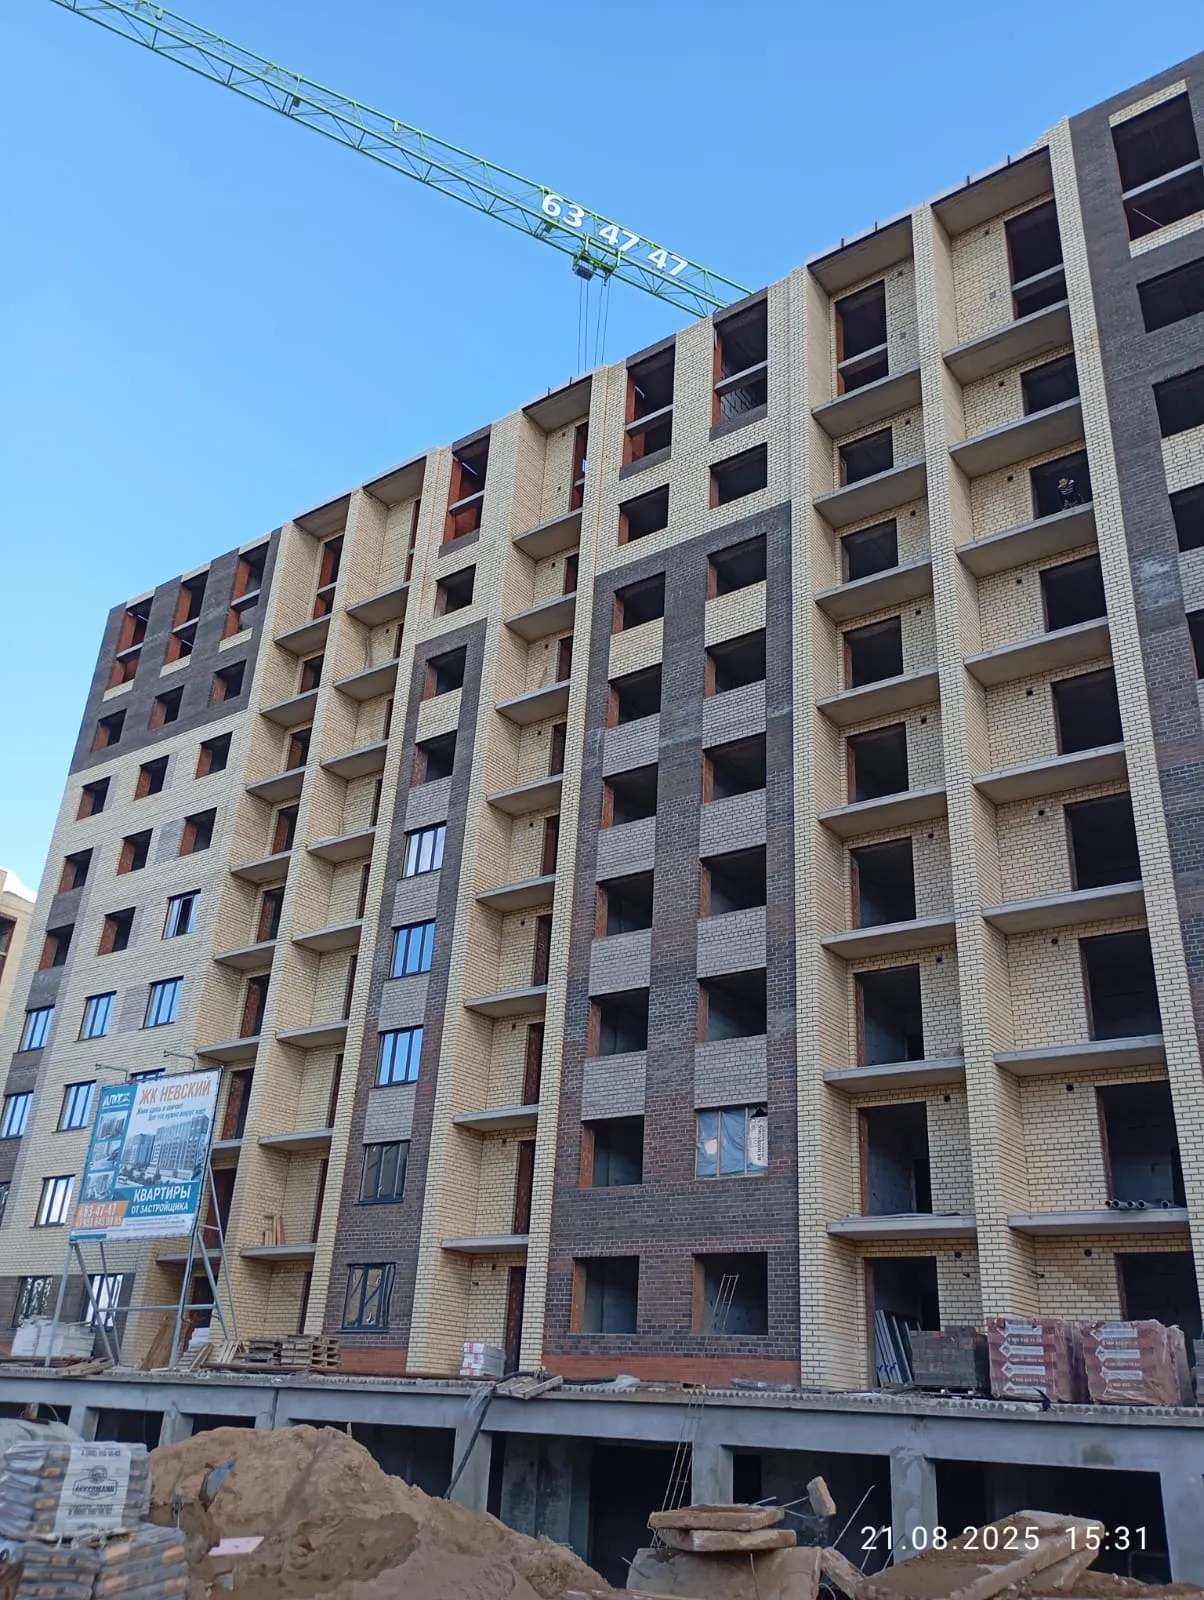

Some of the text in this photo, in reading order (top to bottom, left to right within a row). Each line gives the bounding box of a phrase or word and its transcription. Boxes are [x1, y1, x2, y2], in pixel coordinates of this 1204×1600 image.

[542, 194, 688, 276] 63 47 47
[139, 1077, 212, 1105] ЖК НЕВСКИЙ
[133, 1185, 191, 1202] КВАРТИРЫ
[131, 1201, 188, 1214] ОТ ЗАСТРОЙЩИКА
